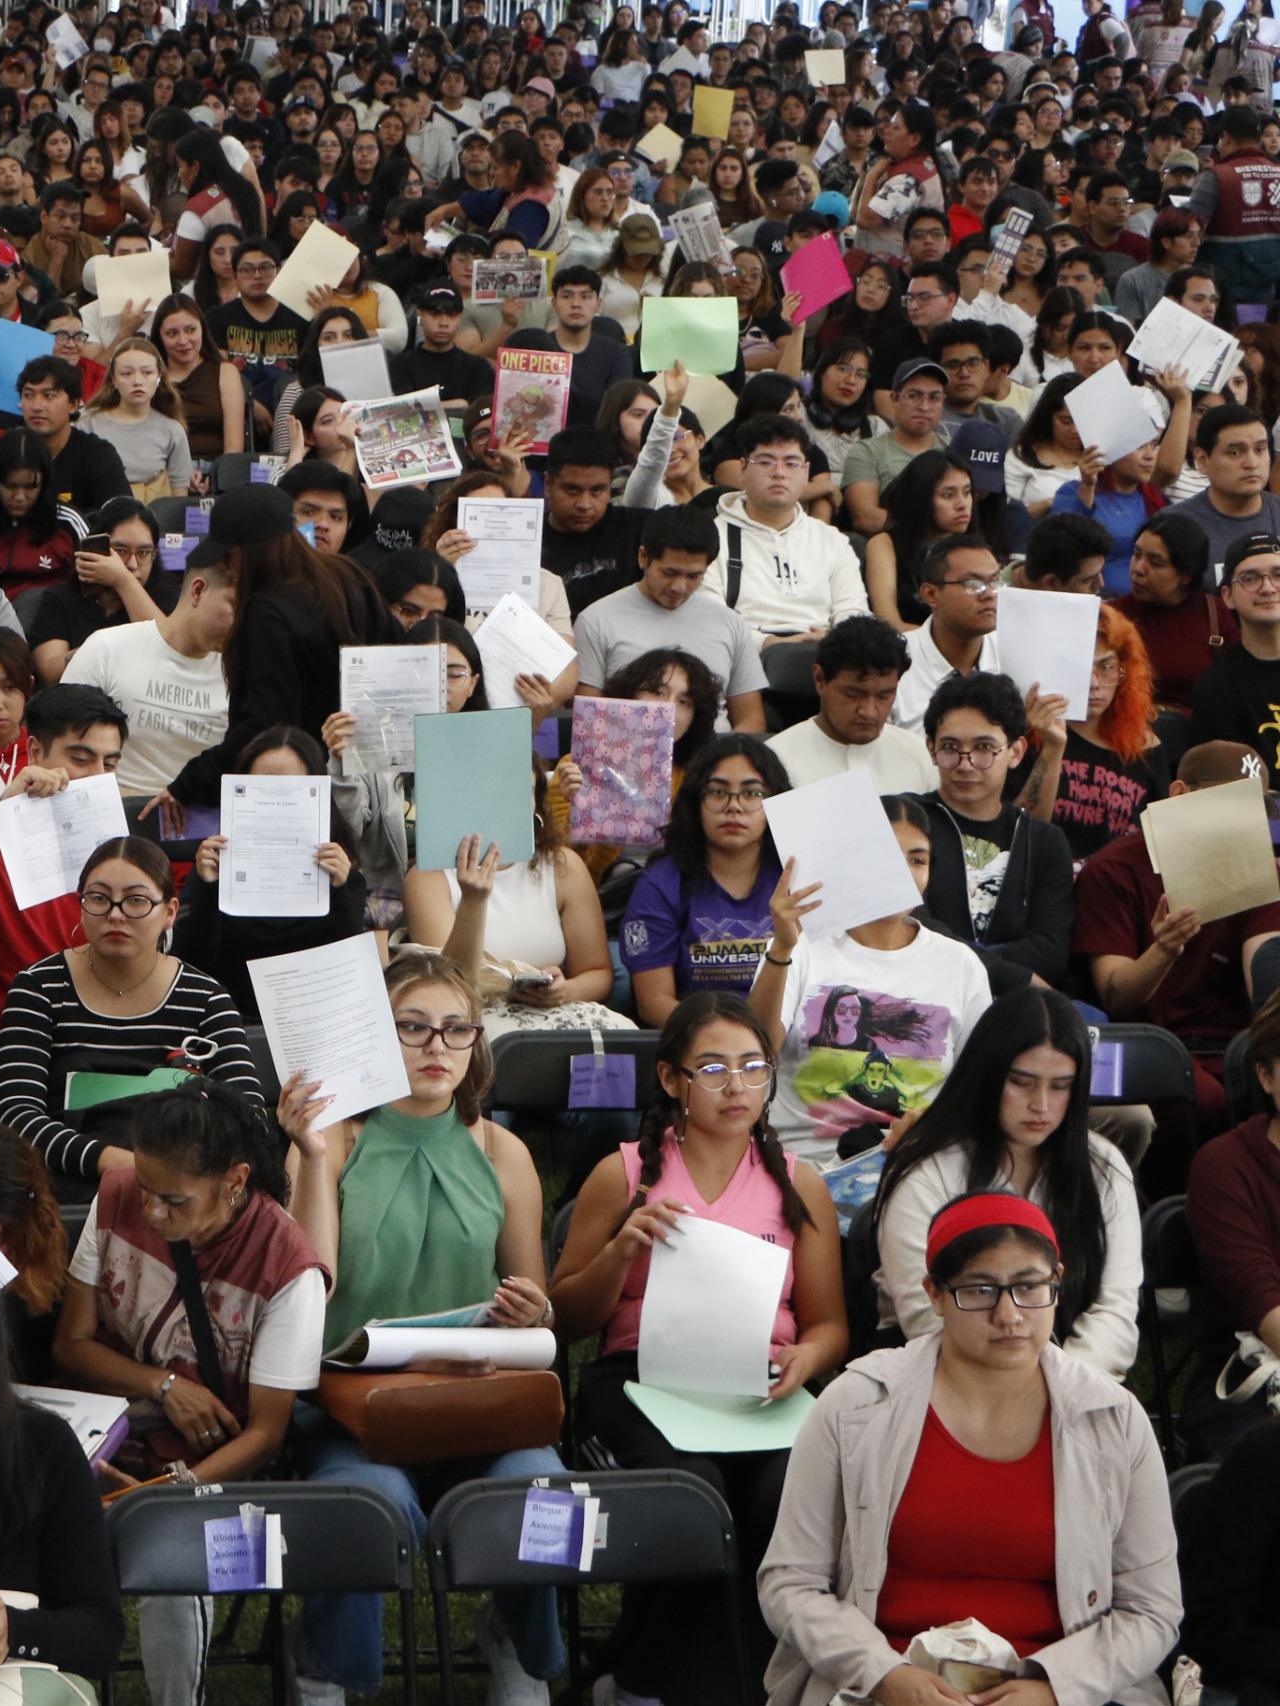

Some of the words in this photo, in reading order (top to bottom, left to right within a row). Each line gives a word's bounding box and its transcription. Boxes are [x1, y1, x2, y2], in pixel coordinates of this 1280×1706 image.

[500, 351, 529, 370] ONE
[528, 354, 567, 374] PIECE
[969, 448, 1000, 463] LOVE
[145, 679, 211, 710] AMERICAN
[137, 708, 175, 734] EAGLE
[1061, 759, 1089, 780] THE
[1094, 765, 1147, 807] ROCKY
[1054, 798, 1105, 826] CTURE
[1069, 779, 1132, 818] HORROR
